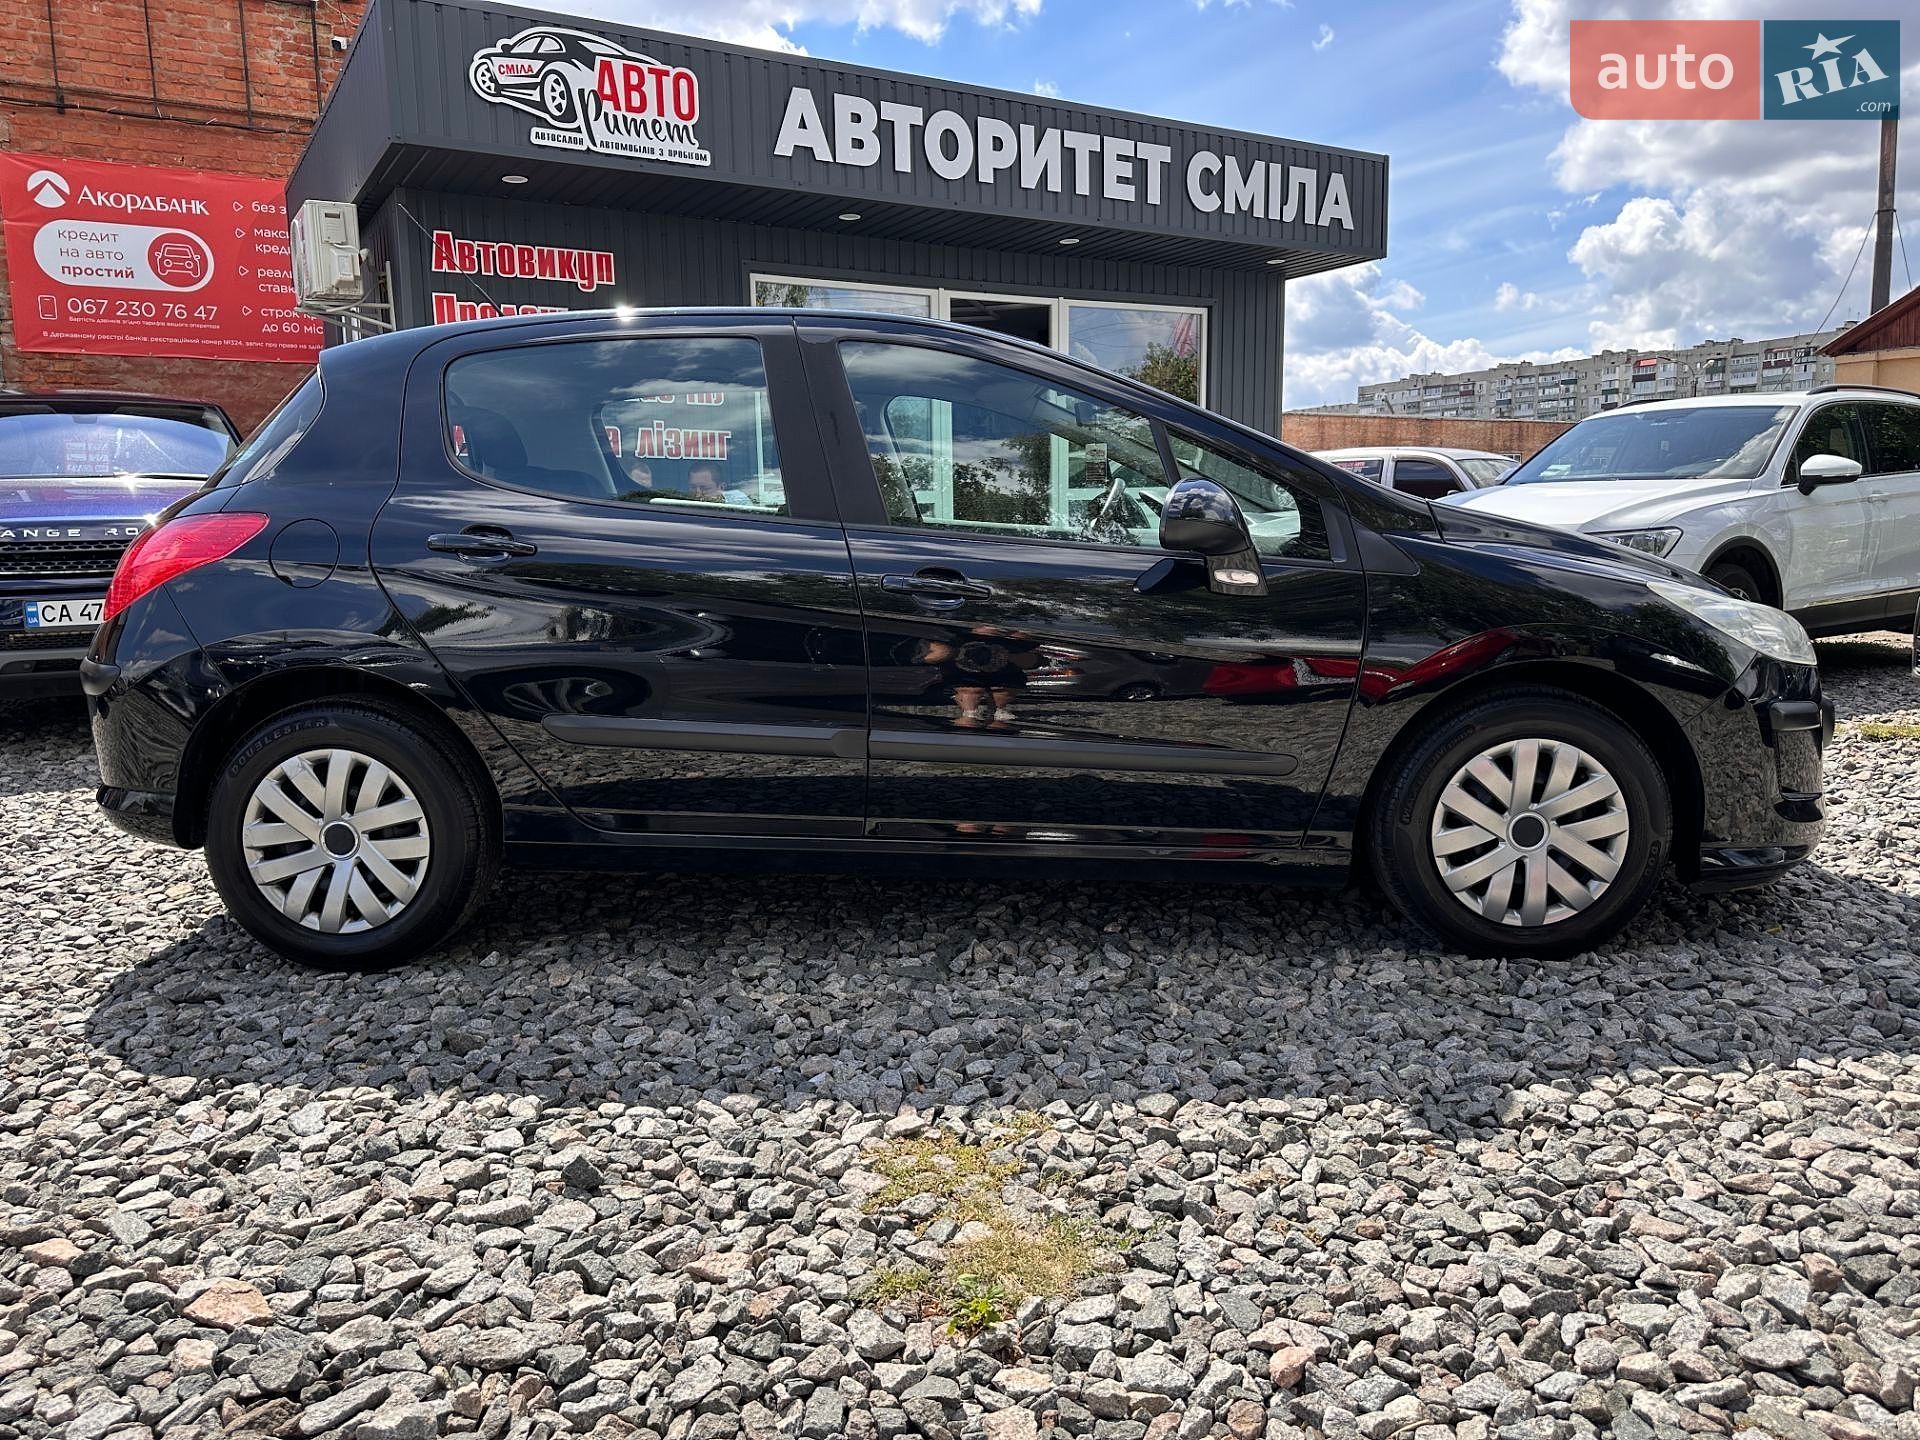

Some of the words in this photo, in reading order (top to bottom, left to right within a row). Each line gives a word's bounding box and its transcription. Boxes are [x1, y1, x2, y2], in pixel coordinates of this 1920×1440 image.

[498, 63, 536, 76] СМІЛА
[597, 59, 696, 121] АВТО
[535, 131, 584, 146] АВТОСАЛОН
[773, 86, 1171, 206] АВТОРИТЕТ
[1186, 151, 1355, 231] СМІЛА
[252, 201, 276, 214] без
[57, 228, 120, 243] кредит
[59, 247, 79, 259] на
[85, 249, 124, 261] авто
[432, 230, 616, 293] Автовикуп
[61, 265, 135, 280] простий
[67, 297, 109, 315] 067
[115, 300, 156, 318] 230
[162, 303, 188, 319] 76
[194, 305, 218, 321] 47
[261, 307, 300, 319] строк
[262, 324, 279, 334] до
[282, 322, 300, 333] 60
[635, 420, 731, 460] лізинг
[28, 616, 39, 624] UA
[41, 604, 73, 623] CA
